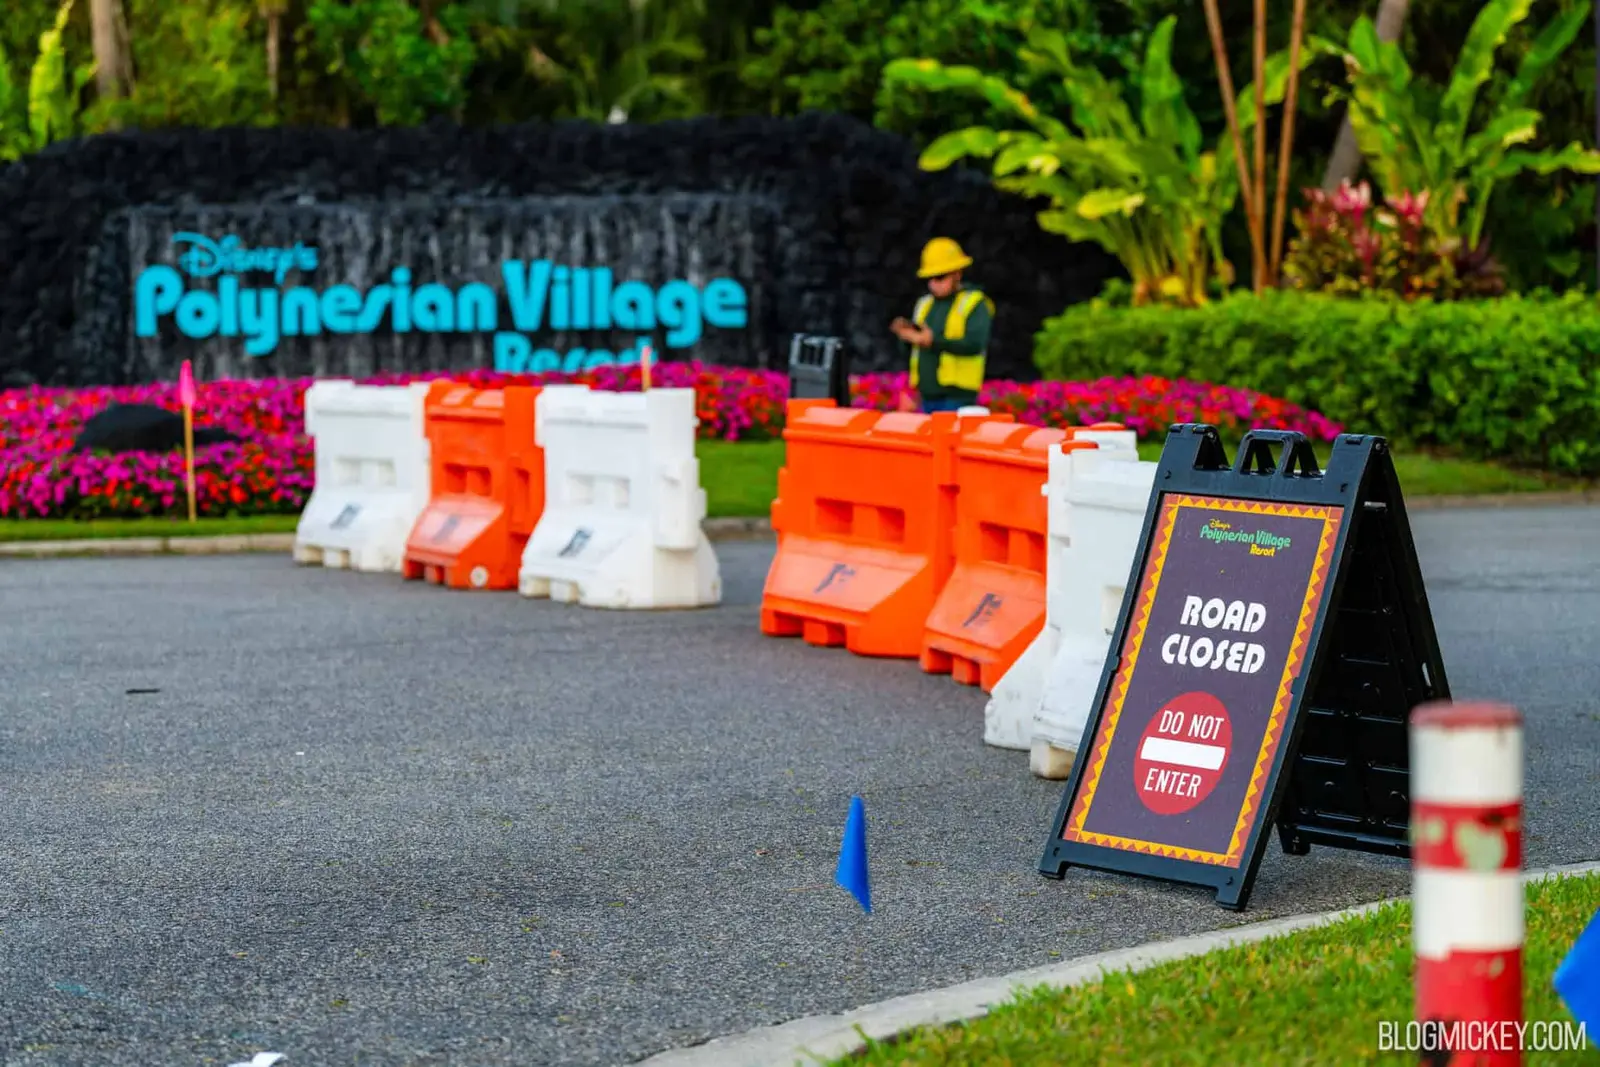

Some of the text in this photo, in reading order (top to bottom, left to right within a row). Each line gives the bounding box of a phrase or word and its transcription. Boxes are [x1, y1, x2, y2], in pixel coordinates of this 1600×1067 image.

[171, 231, 319, 284] Disney's
[135, 259, 747, 355] Polynesian Village
[1200, 525, 1291, 550] Polynesian Village
[1250, 543, 1276, 557] Resort
[1180, 595, 1266, 633] ROAD
[1161, 633, 1266, 674] CLOSED
[1158, 710, 1224, 740] DO NOT
[1144, 768, 1202, 798] ENTER
